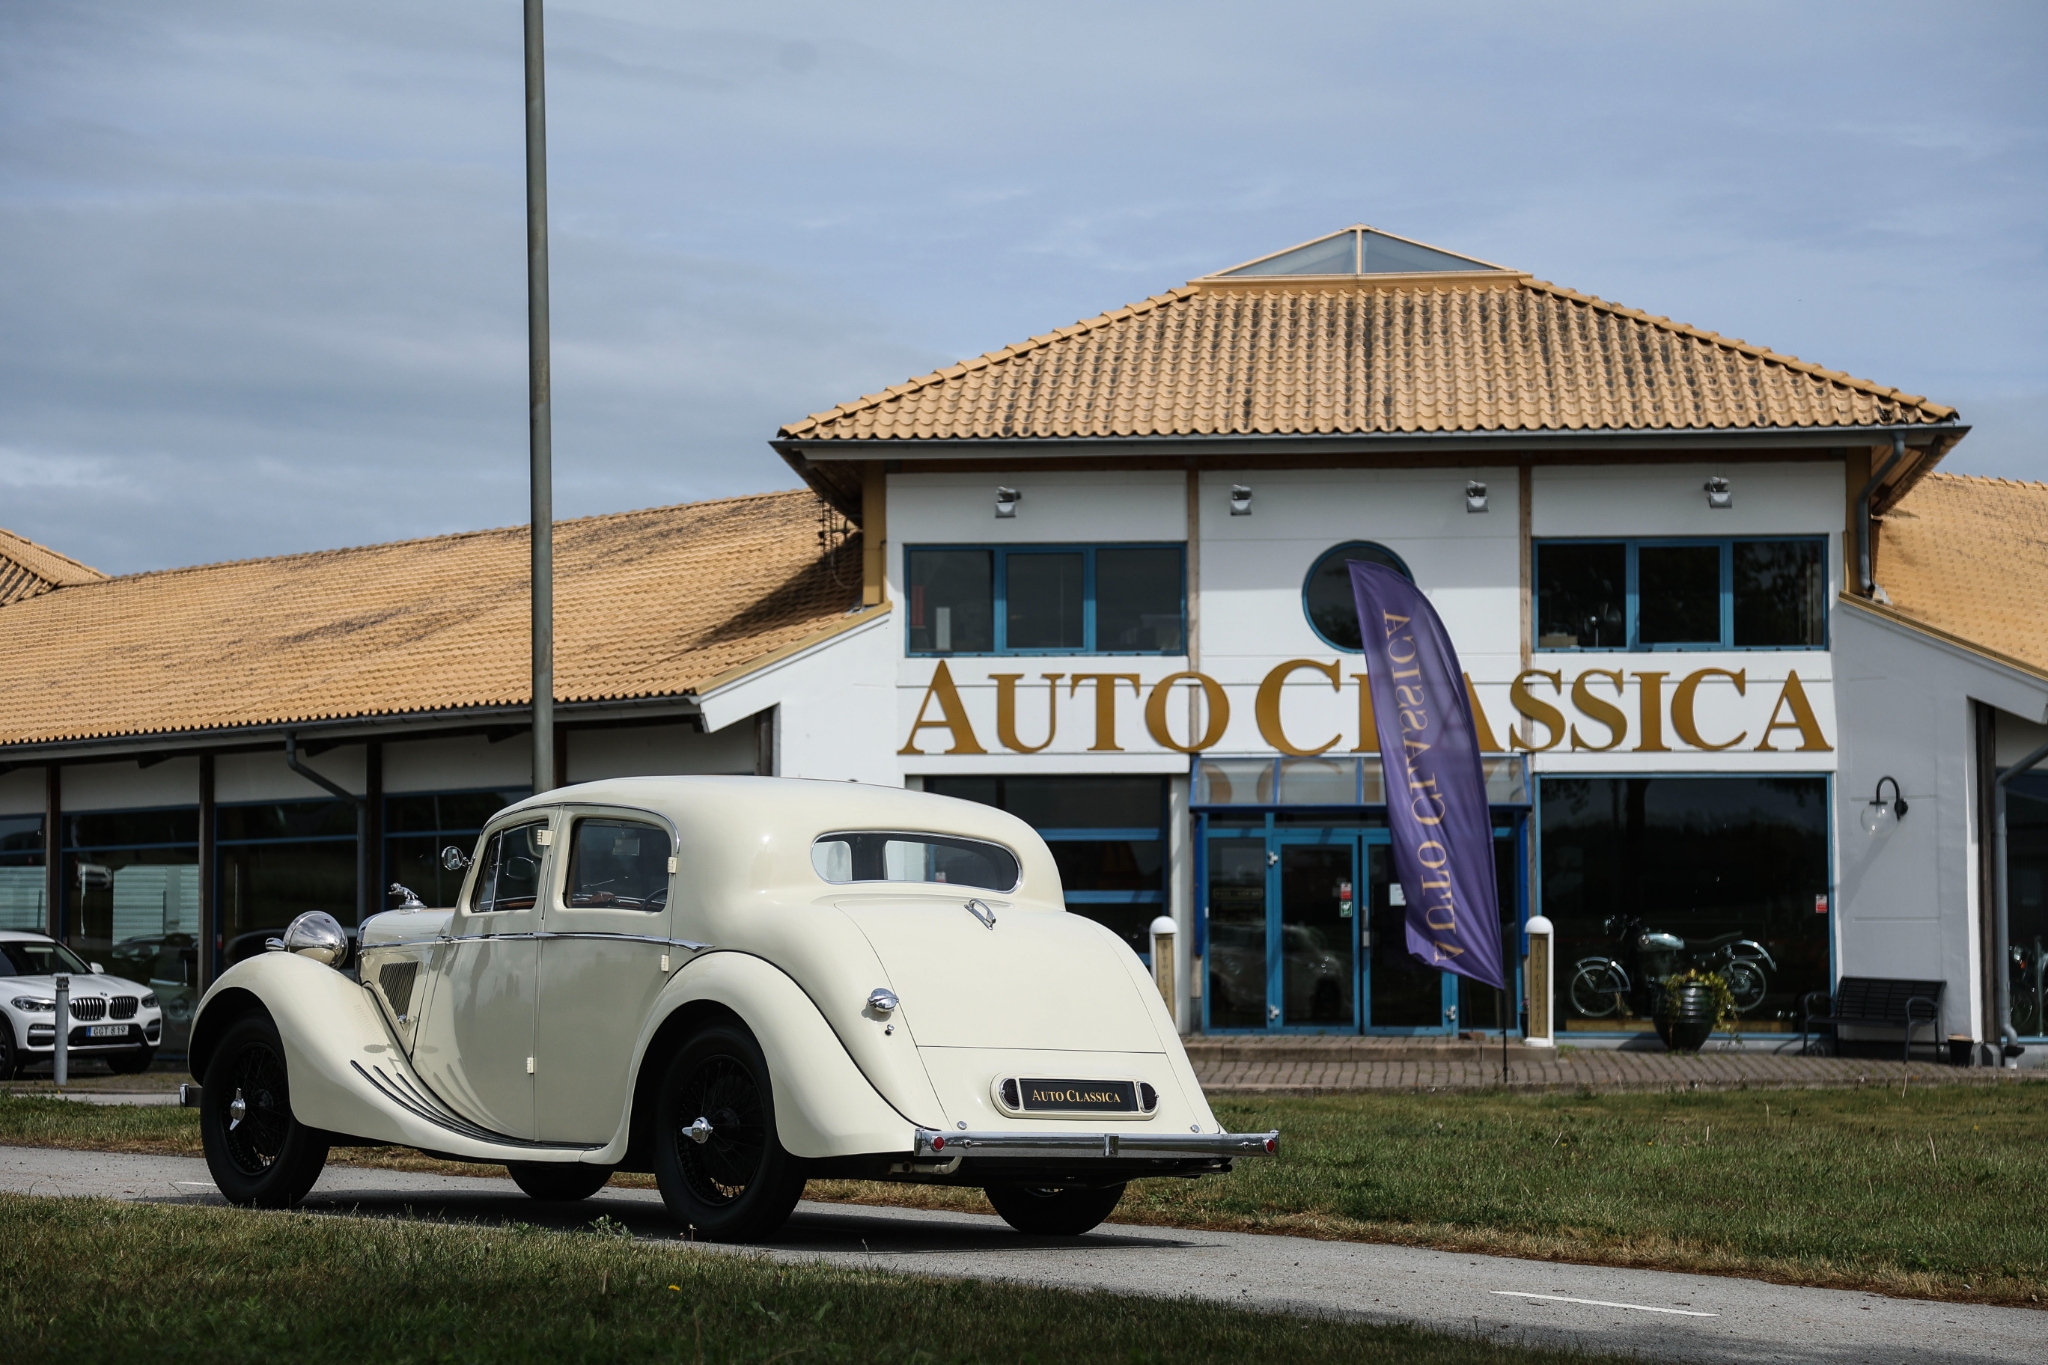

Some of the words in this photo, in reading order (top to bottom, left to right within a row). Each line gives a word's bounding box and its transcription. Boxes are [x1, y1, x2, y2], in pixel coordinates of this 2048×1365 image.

[896, 658, 1231, 756] AUTO
[1032, 1089, 1065, 1102] AUTO
[1066, 1089, 1121, 1103] CLASSICA
